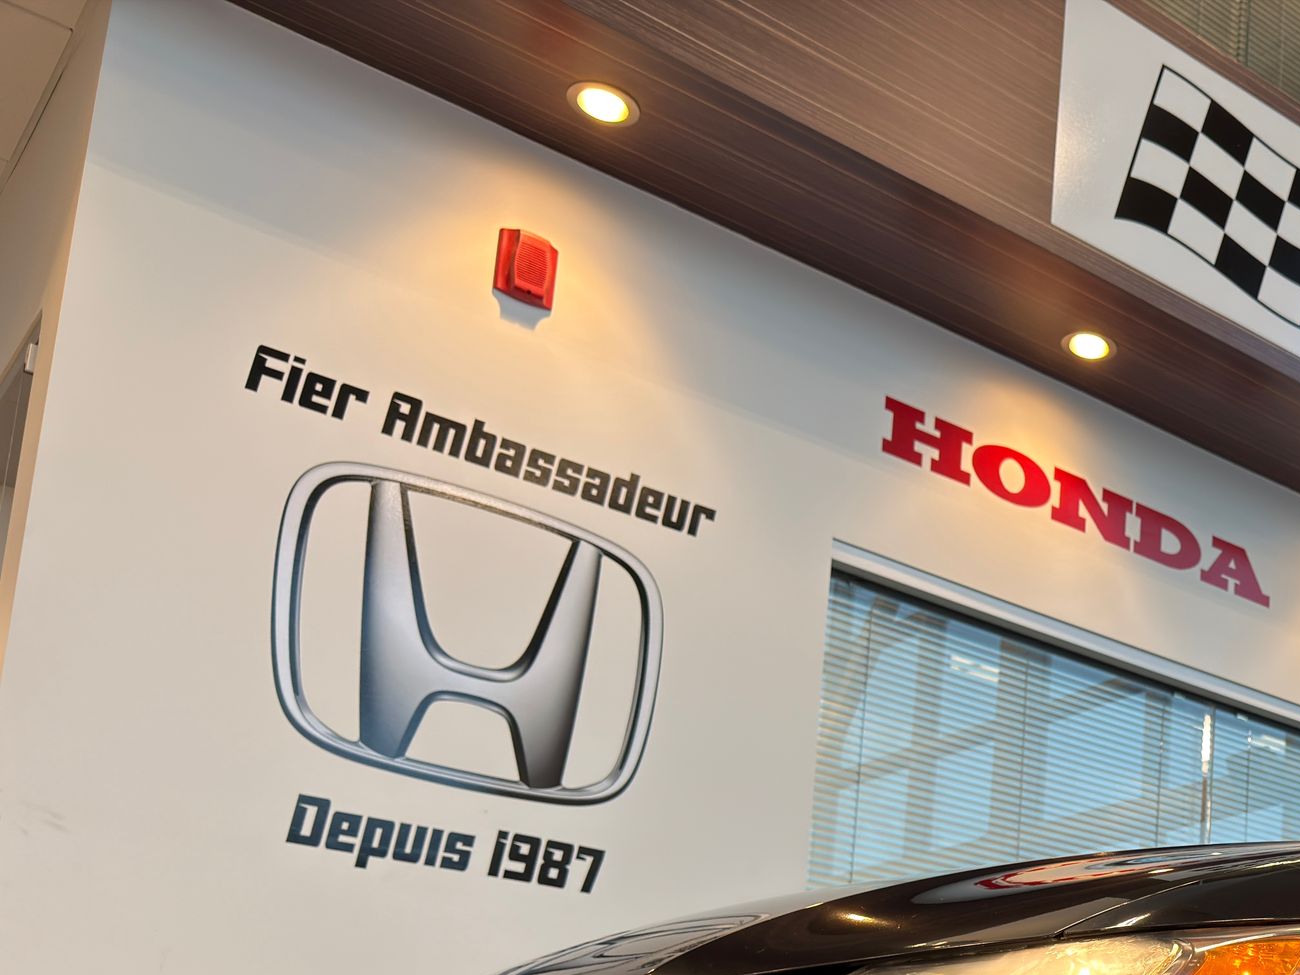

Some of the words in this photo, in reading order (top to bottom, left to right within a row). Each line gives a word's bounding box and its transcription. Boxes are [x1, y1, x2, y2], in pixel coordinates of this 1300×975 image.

[244, 344, 370, 420] Fier
[381, 391, 717, 537] Ambassadeur
[881, 396, 1270, 608] HONDA
[285, 794, 476, 872] Depuis
